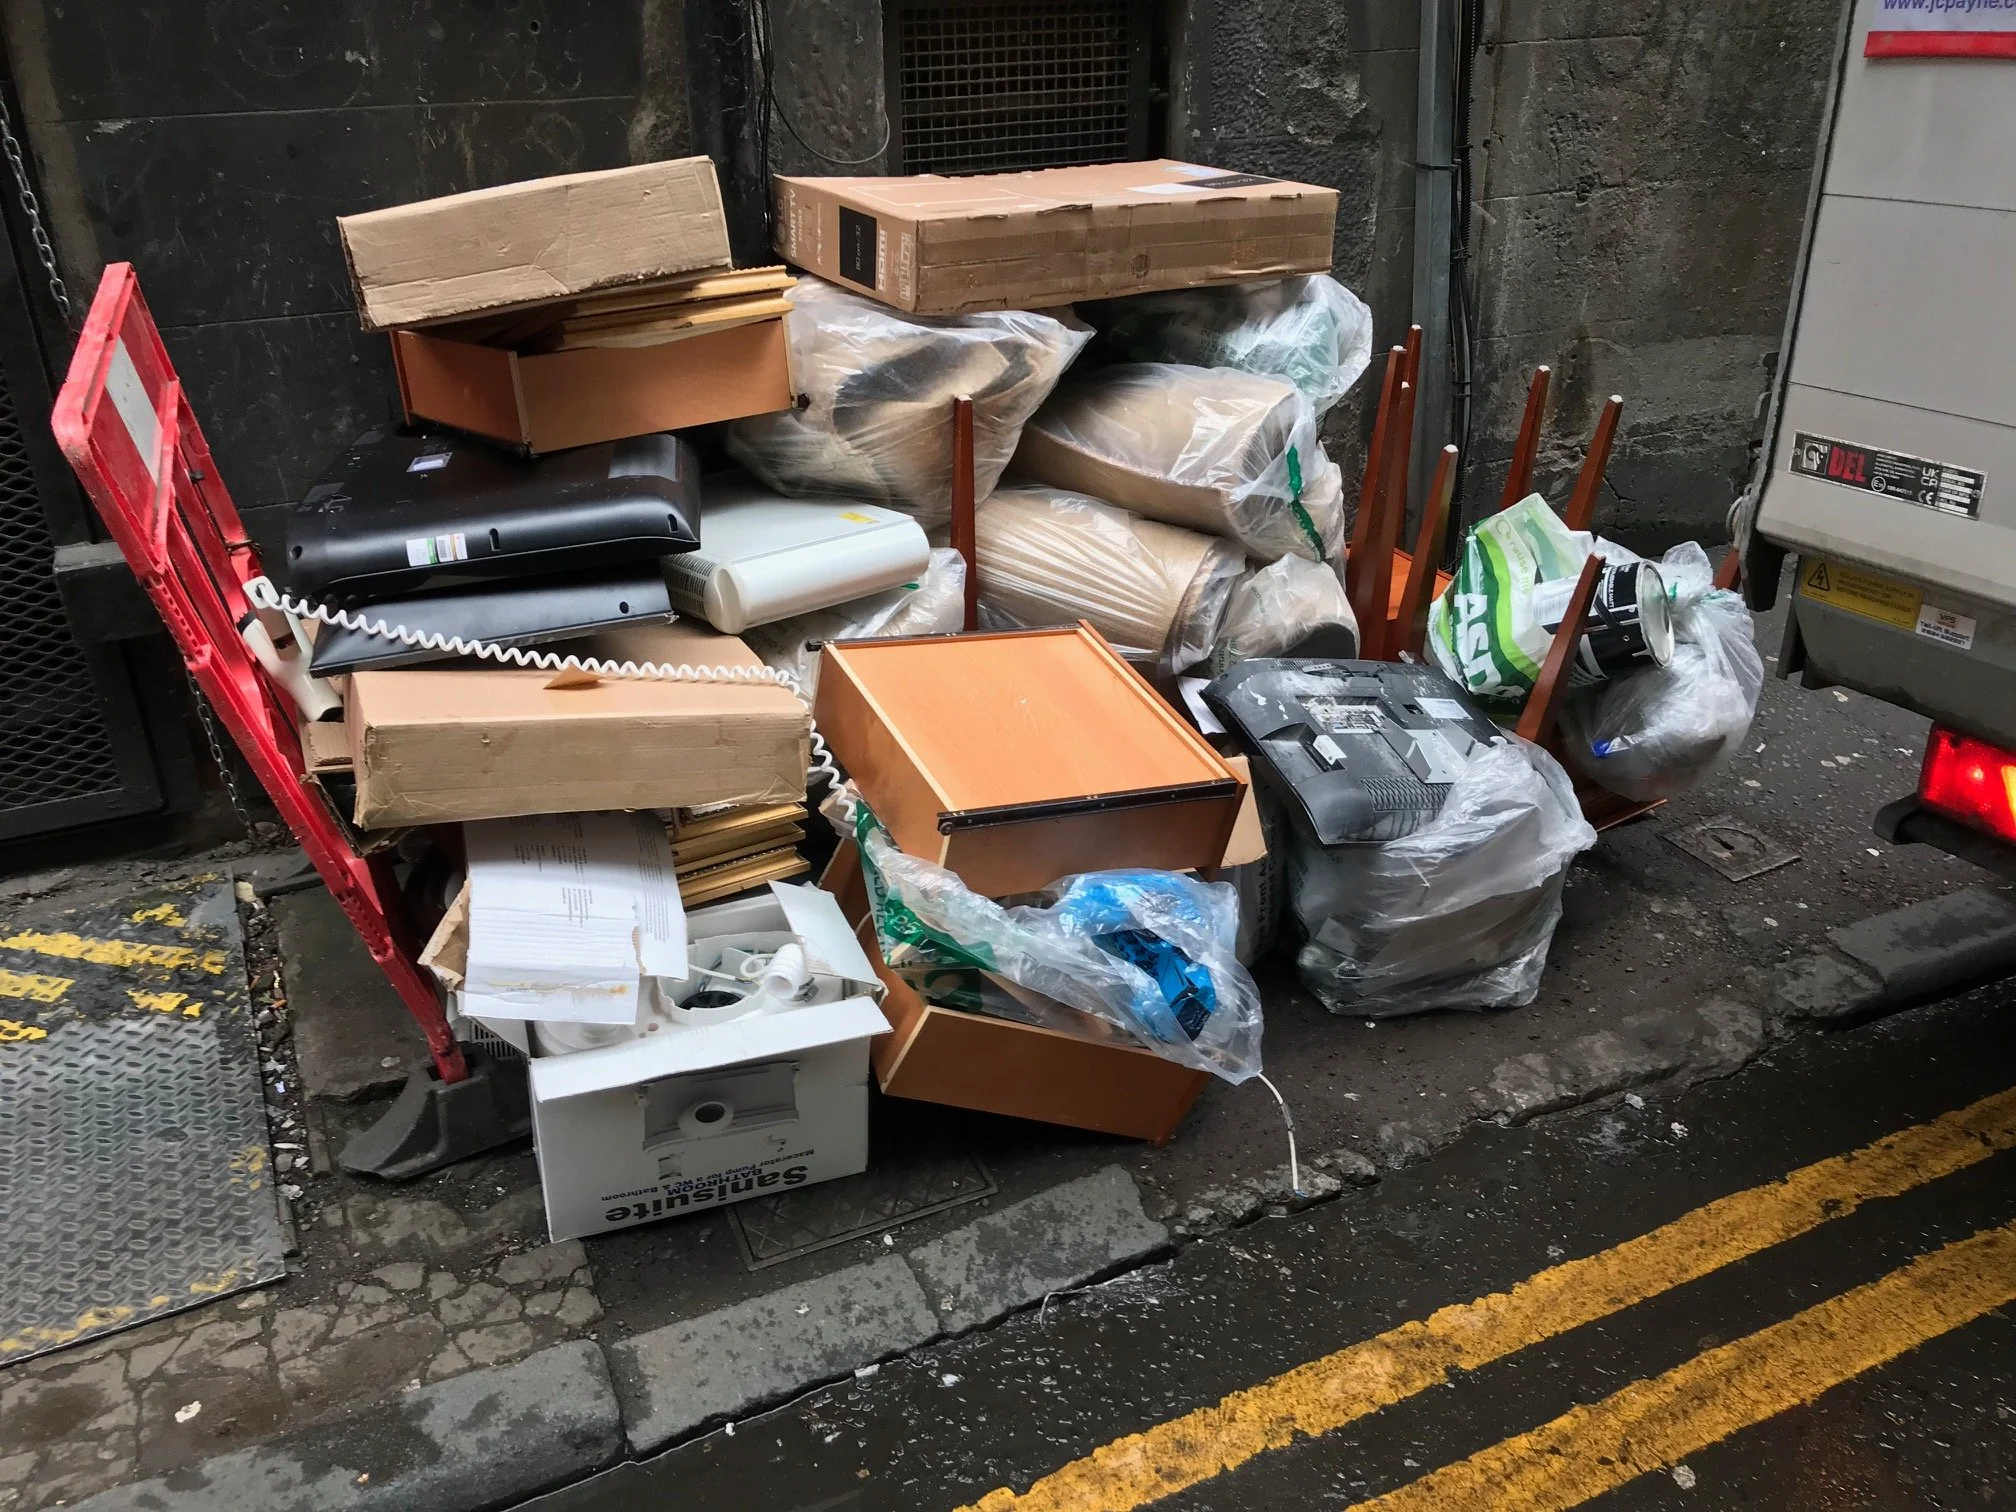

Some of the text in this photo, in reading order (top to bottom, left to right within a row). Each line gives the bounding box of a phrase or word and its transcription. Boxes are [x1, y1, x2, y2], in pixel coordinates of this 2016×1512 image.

[789, 188, 796, 207] TV
[1828, 446, 1867, 483] DEL
[759, 1149, 815, 1167] Macerator
[708, 1172, 722, 1180] for
[724, 1163, 756, 1176] Pump
[667, 1168, 763, 1197] BATHROOM
[674, 1178, 694, 1187] WC
[601, 1185, 659, 1202] Bathroom
[604, 1165, 809, 1222] Sanisuite
